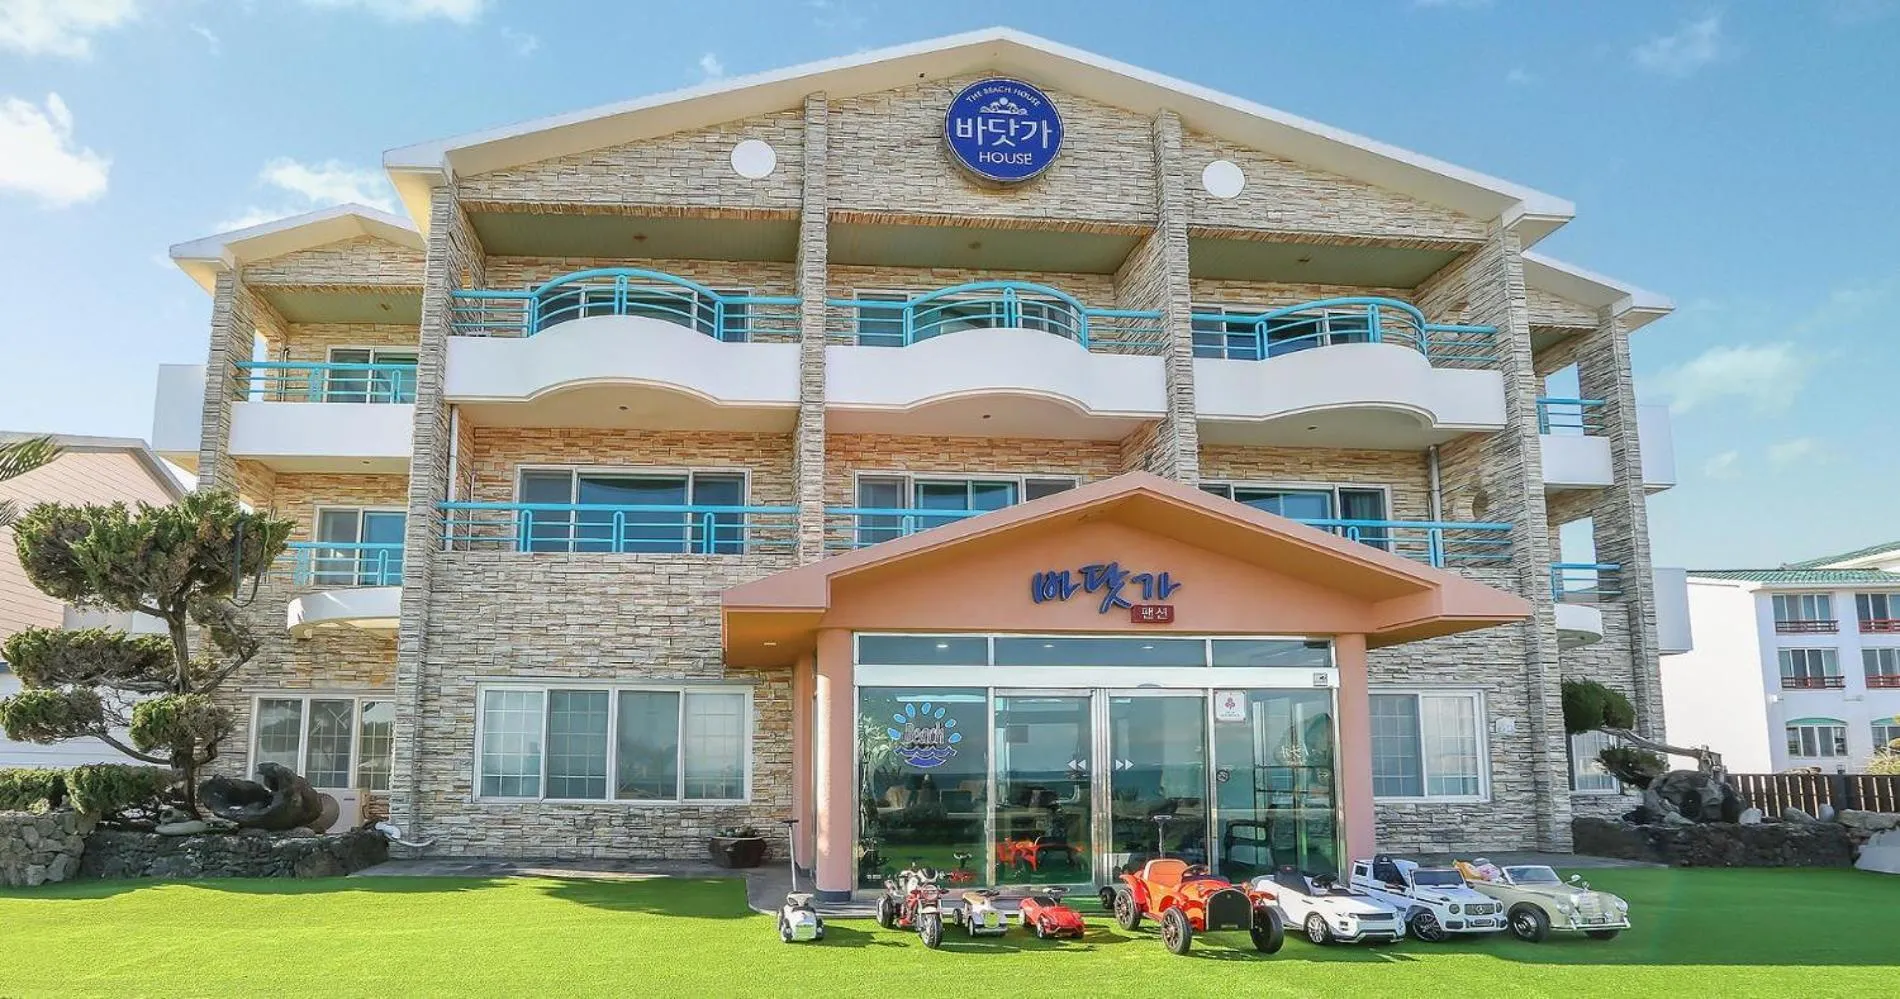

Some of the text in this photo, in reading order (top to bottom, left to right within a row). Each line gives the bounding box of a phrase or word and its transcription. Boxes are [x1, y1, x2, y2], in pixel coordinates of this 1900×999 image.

[966, 85, 1041, 107] THE BEACH HOUSE
[956, 116, 1053, 149] 바닷가
[979, 151, 1033, 165] HOUSE
[1032, 562, 1181, 613] 바닷가
[902, 722, 945, 744] Beach
